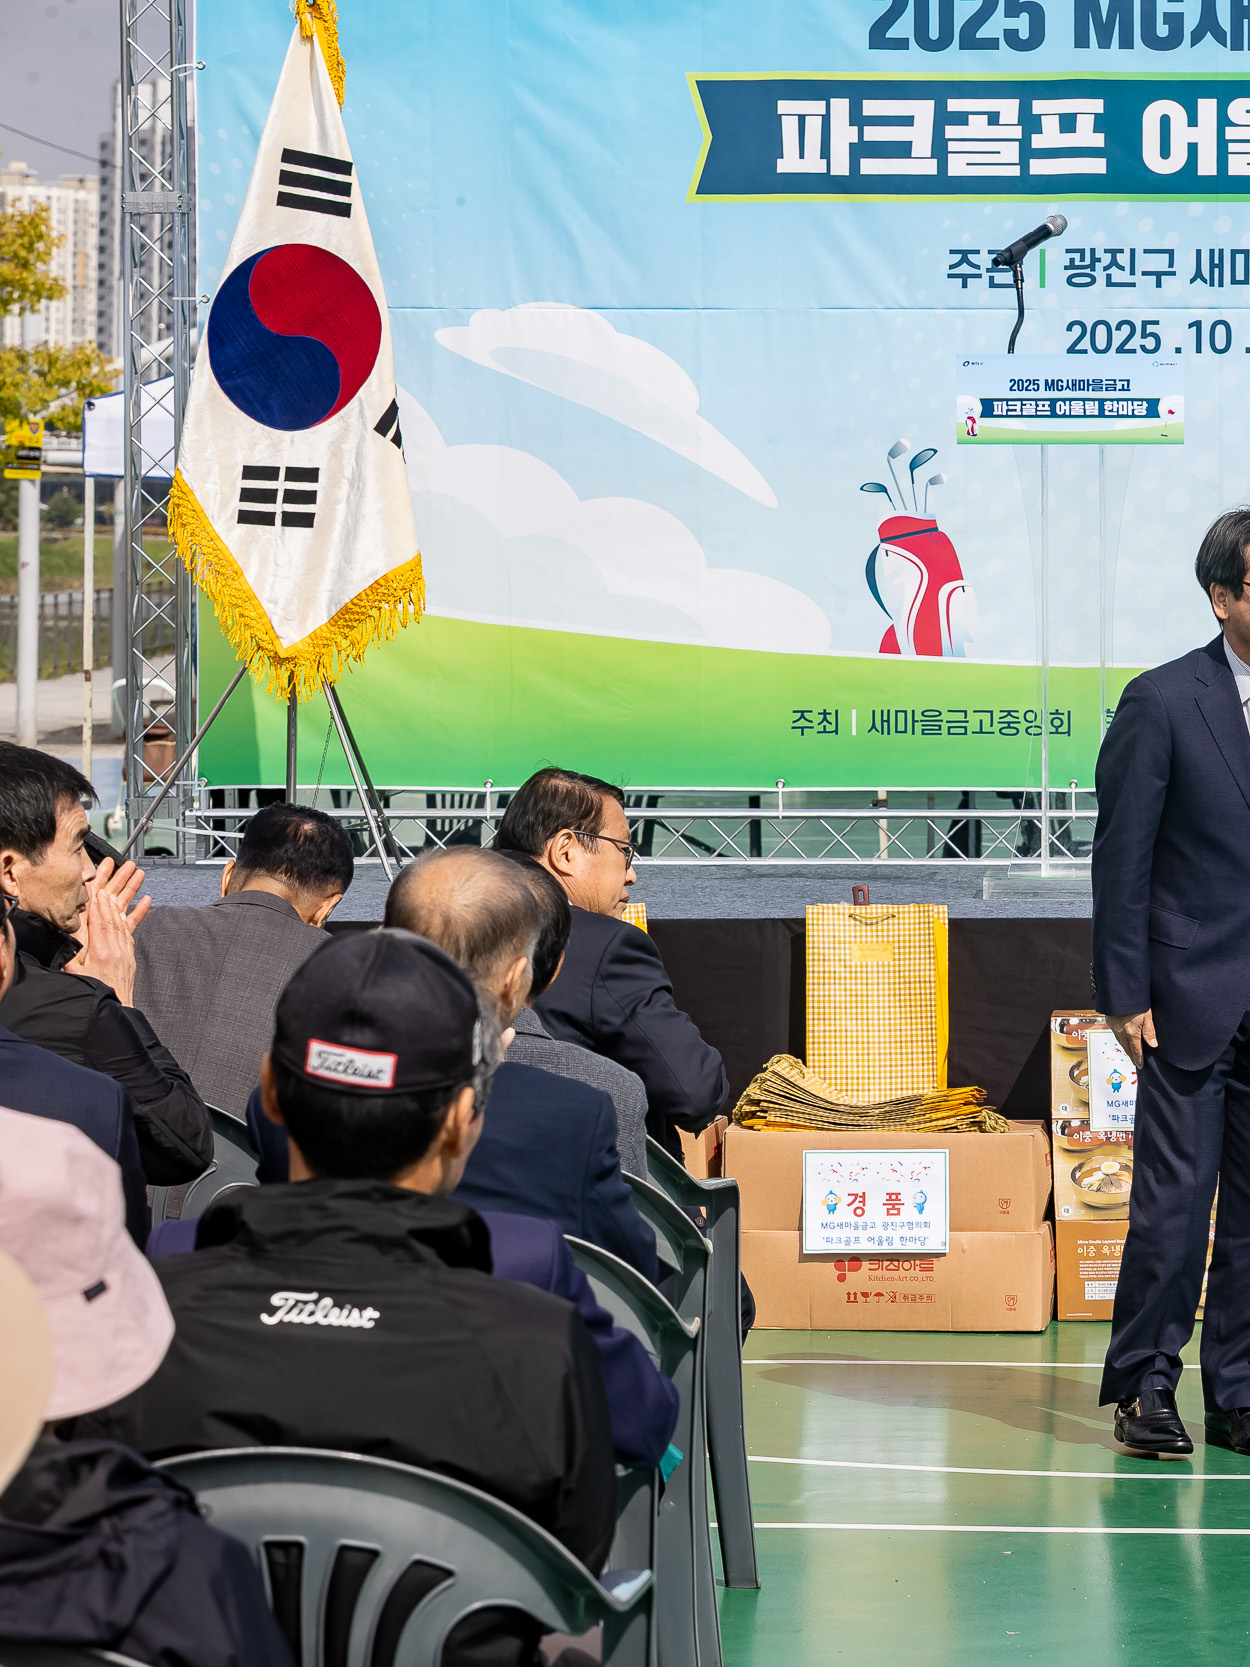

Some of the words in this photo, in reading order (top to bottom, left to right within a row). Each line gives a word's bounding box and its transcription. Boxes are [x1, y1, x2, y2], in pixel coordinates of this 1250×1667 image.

[868, 0, 1046, 52] 2025
[775, 97, 1108, 177] 파크골프
[1063, 246, 1178, 290] 광진구
[1065, 319, 1162, 355] 2025
[1009, 378, 1040, 392] 2025
[1044, 378, 1131, 392] MG새마을금고
[992, 400, 1051, 417] 파크골프
[1055, 400, 1099, 417] 어울림
[1103, 399, 1149, 417] 한마당
[791, 708, 840, 737] 주최
[867, 707, 1072, 738] 새마을금고중앙회
[310, 1048, 386, 1081] Titleist
[1073, 1131, 1094, 1143] 이중
[820, 1221, 877, 1231] MG새마을금고
[881, 1221, 931, 1231] 광진구협의회
[867, 1236, 894, 1247] 어울림
[1077, 1245, 1097, 1256] 이중
[260, 1291, 381, 1329] Titleist
